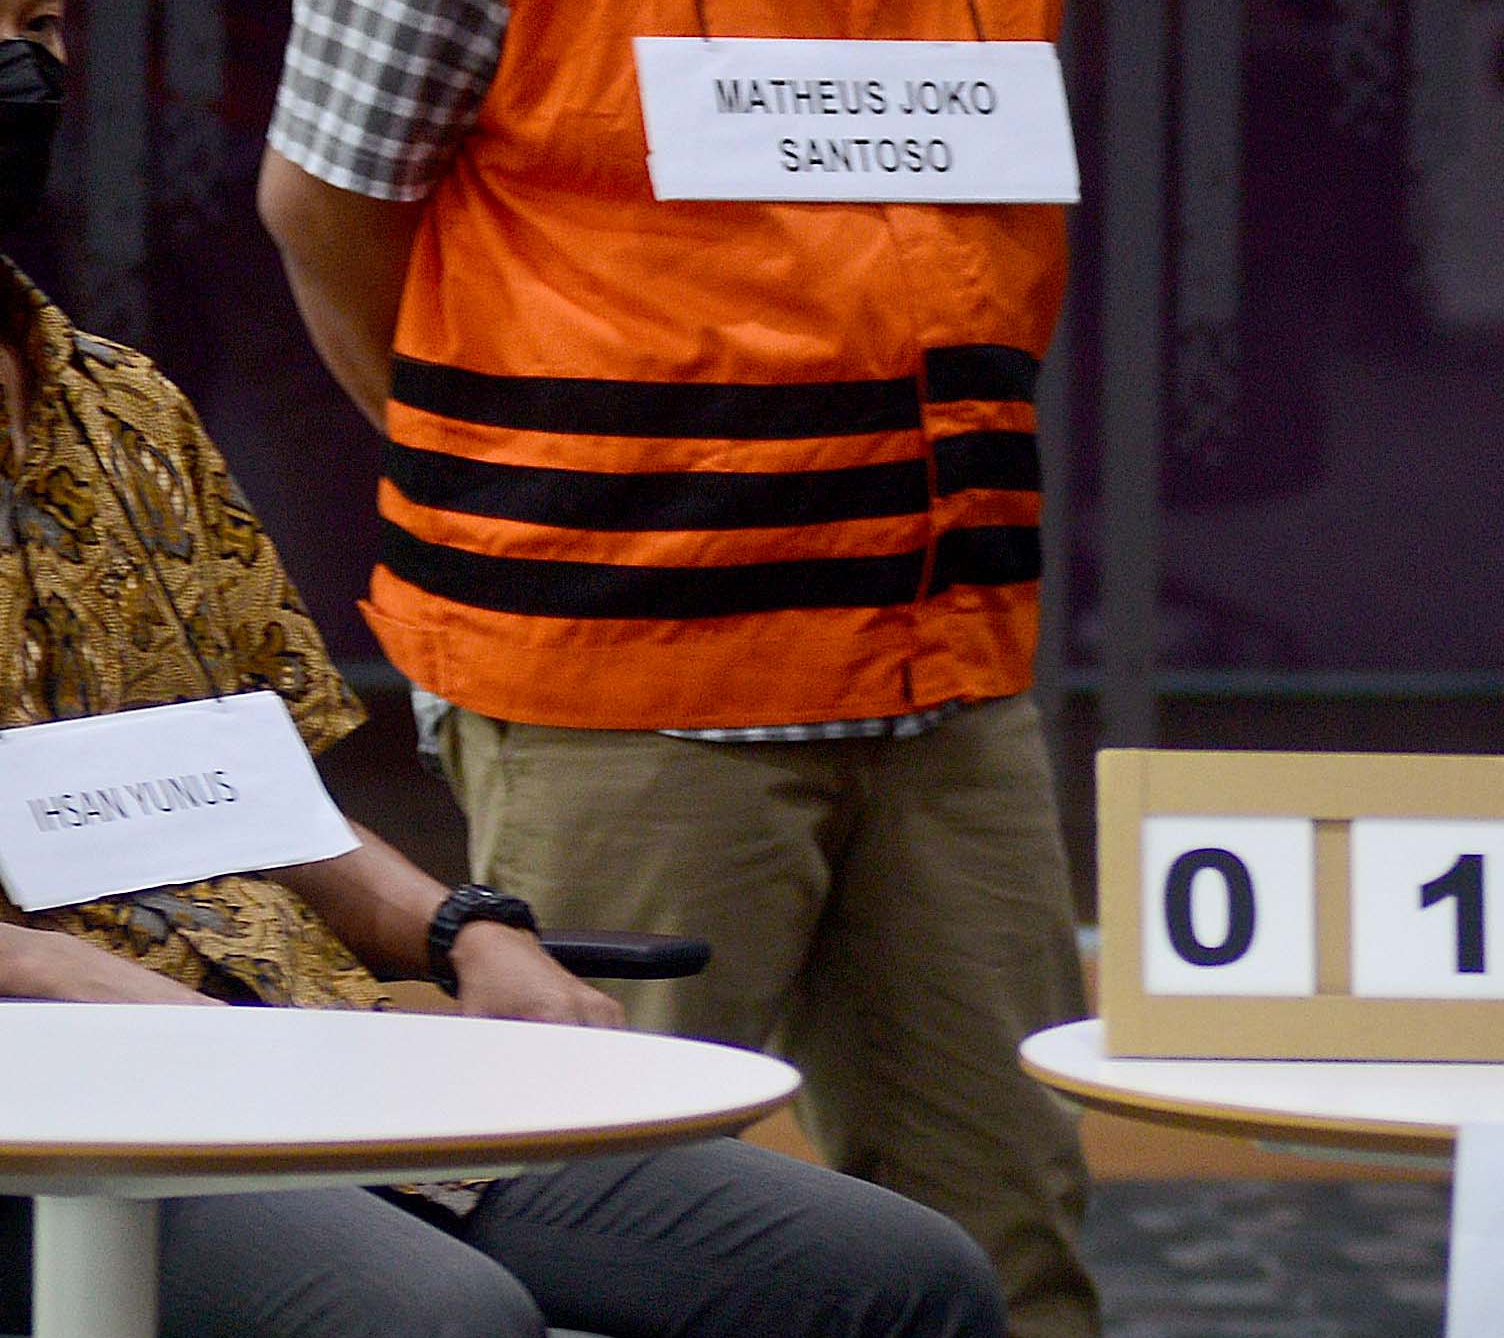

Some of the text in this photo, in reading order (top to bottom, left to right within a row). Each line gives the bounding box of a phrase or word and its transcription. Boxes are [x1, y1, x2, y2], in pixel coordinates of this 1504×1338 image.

[713, 78, 998, 116] MATHEUS JOKO
[779, 137, 953, 173] SANTOSO
[27, 769, 241, 833] IHSAN YUNUS
